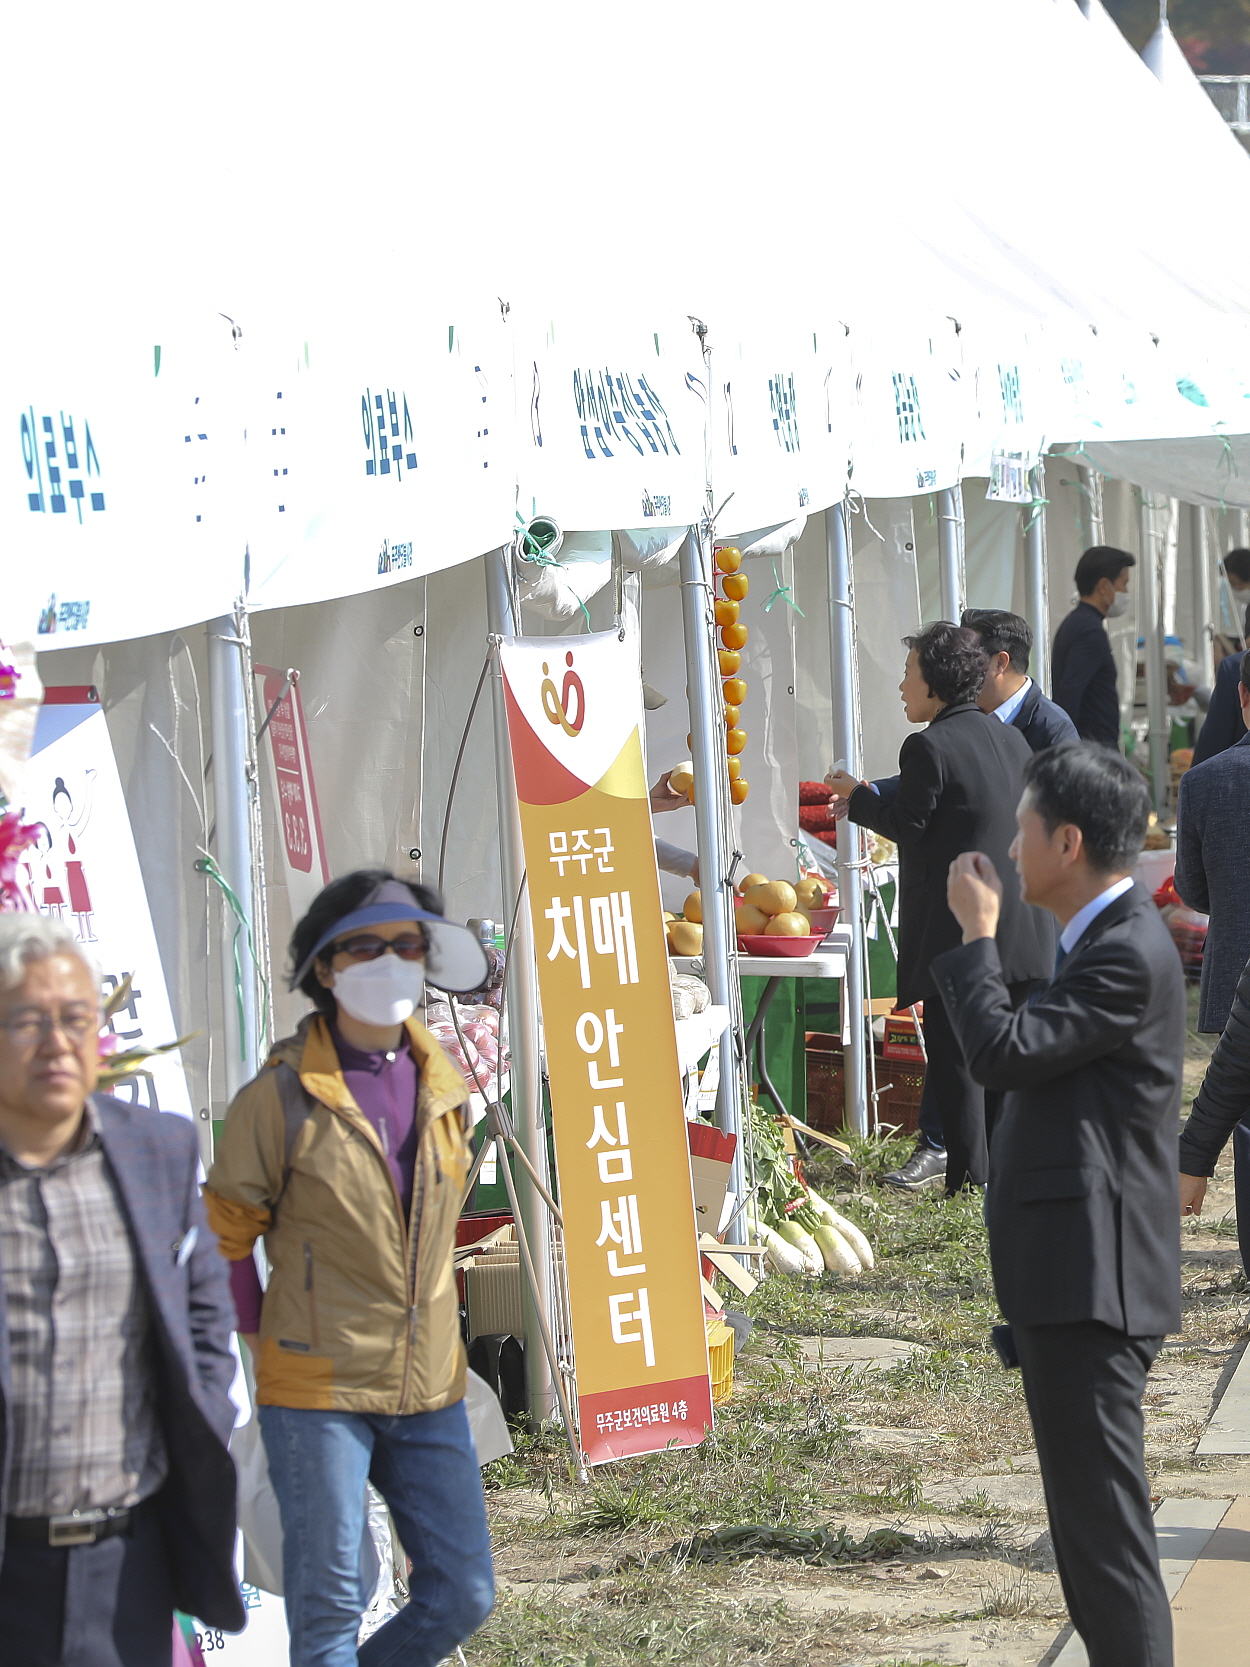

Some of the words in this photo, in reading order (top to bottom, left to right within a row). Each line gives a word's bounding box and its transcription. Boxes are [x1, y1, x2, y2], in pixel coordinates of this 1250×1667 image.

[549, 827, 615, 877] 무주군
[544, 890, 640, 989] 치매
[575, 1008, 656, 1368] 안심센터
[595, 1402, 671, 1435] 무주군보건의료원
[671, 1399, 689, 1421] 4층
